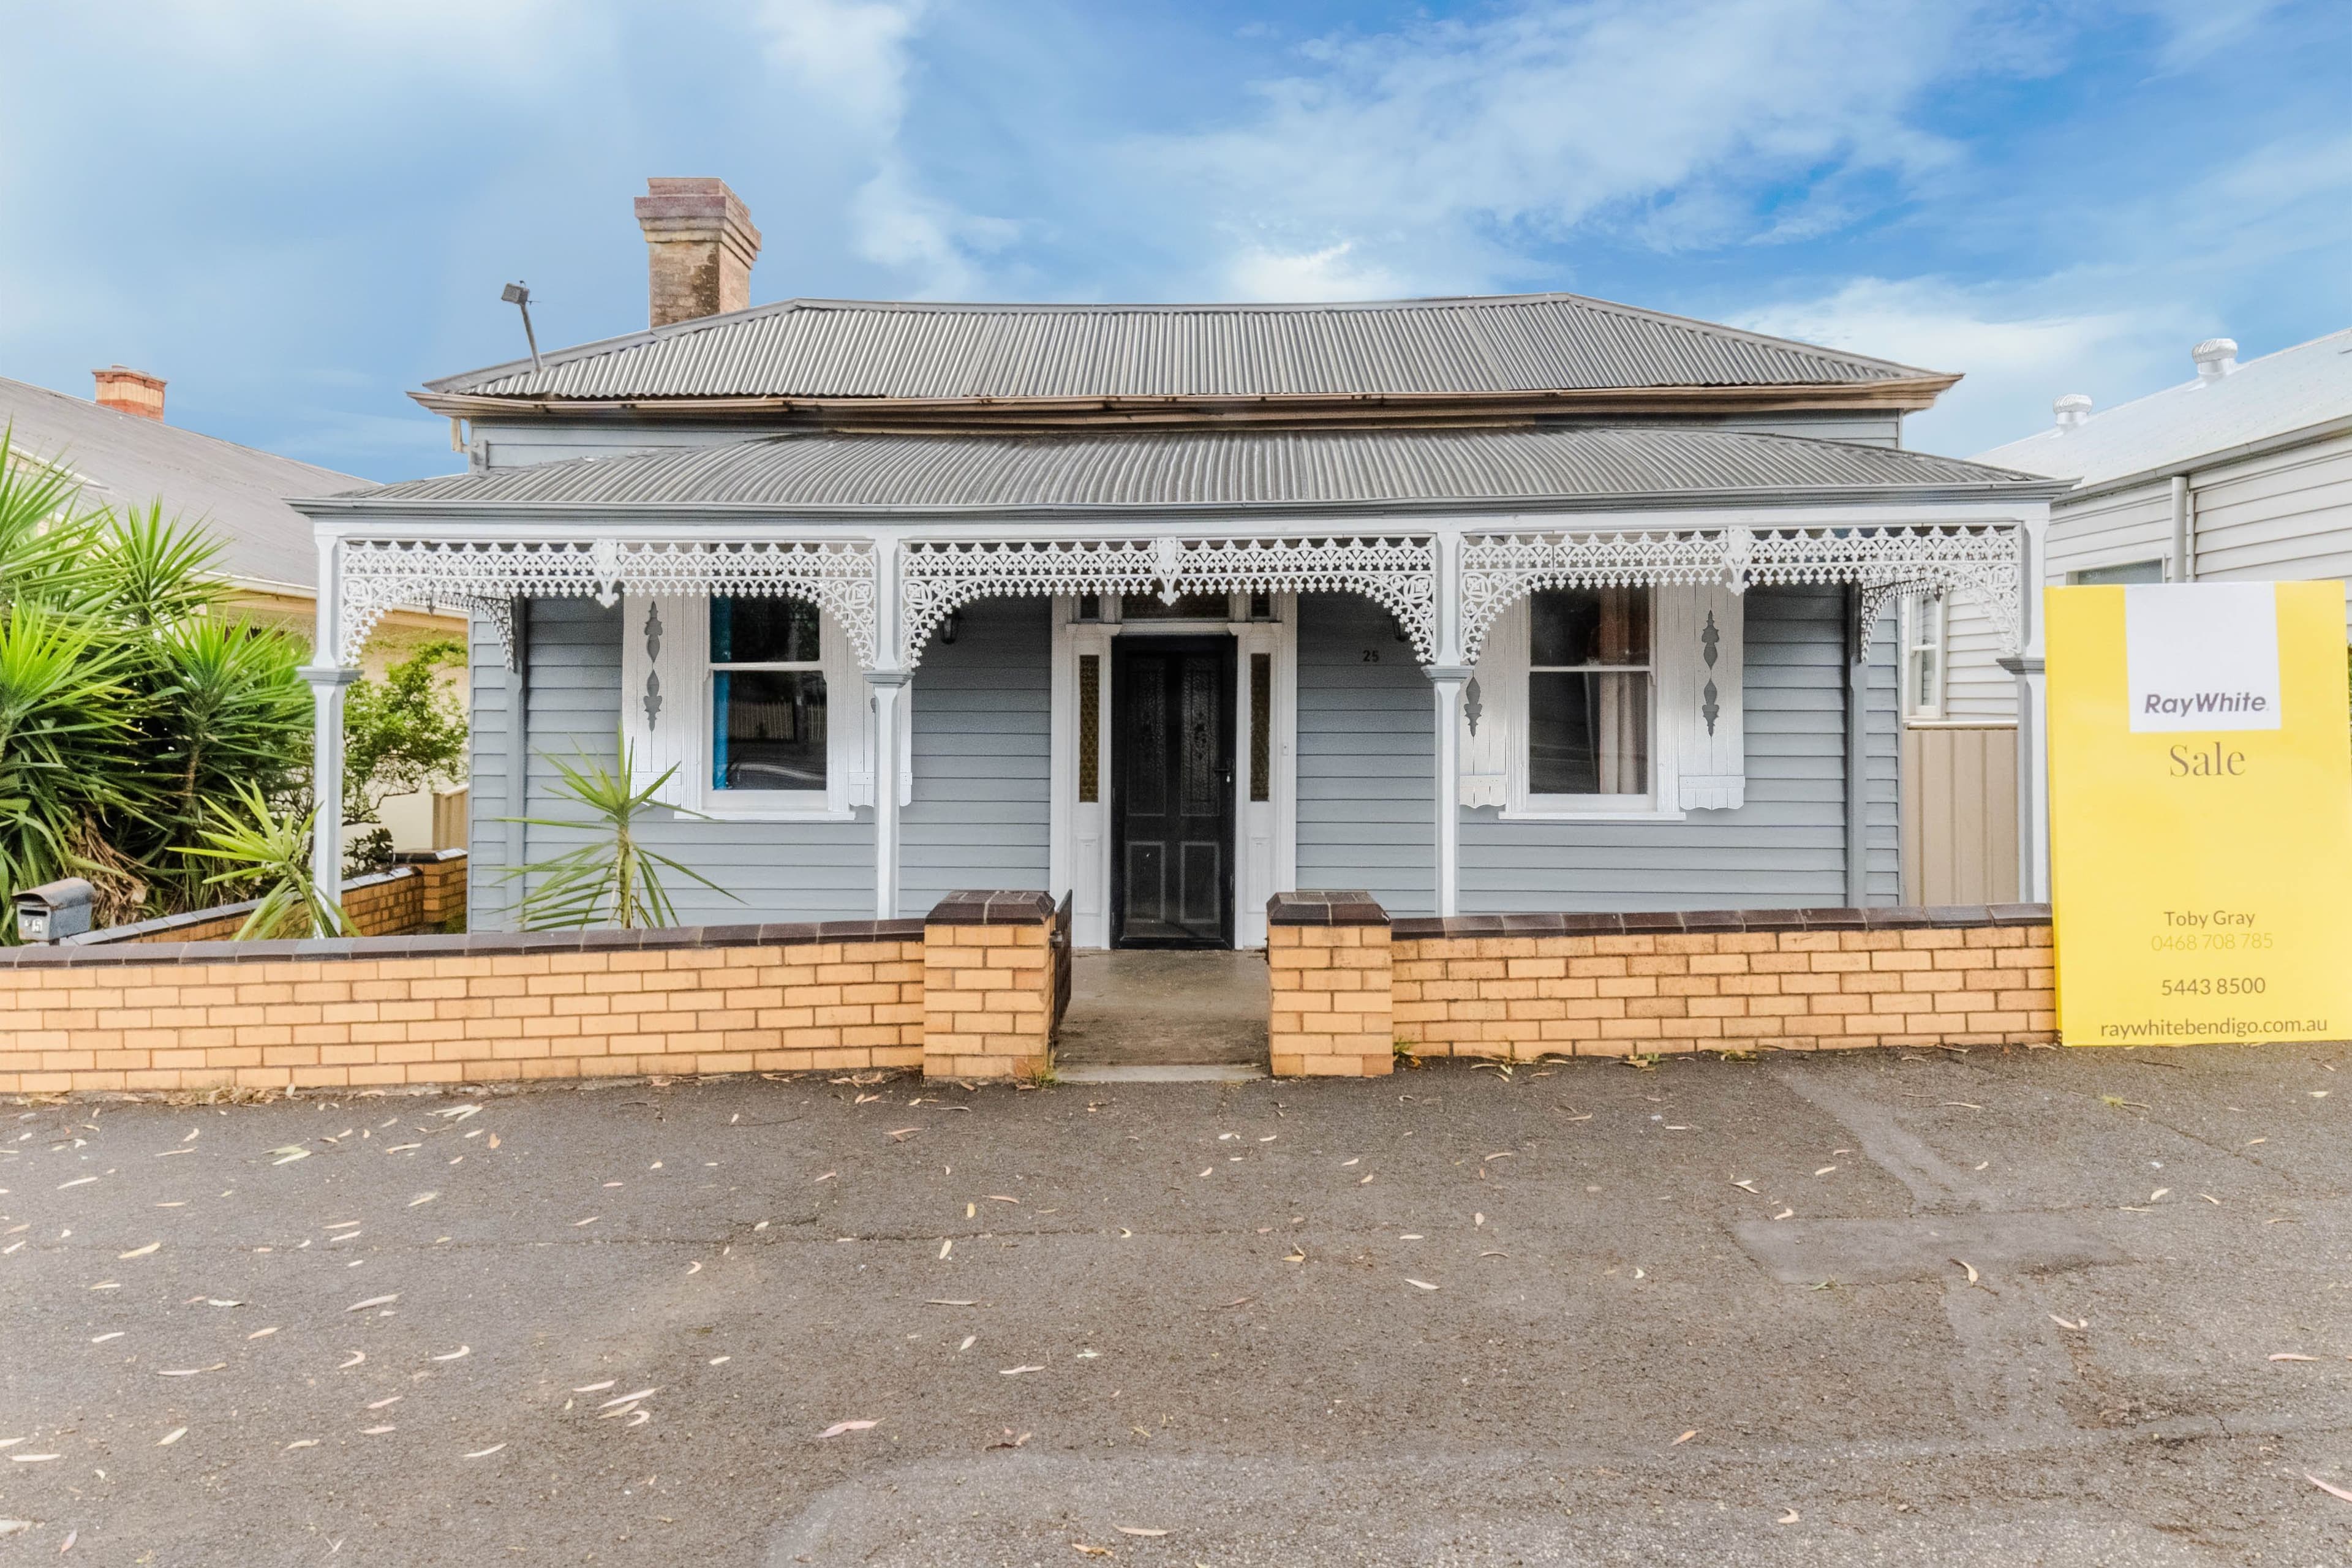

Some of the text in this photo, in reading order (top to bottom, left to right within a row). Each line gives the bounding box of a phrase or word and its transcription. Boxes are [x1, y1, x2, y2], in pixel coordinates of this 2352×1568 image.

[1362, 649, 1379, 663] 25
[2169, 741, 2245, 777] Sale
[2164, 910, 2256, 929] Toby Gray
[2151, 932, 2274, 952] 0468 708 785
[2162, 977, 2266, 996] 5443 8500
[2101, 1017, 2328, 1040] raywhitebendigo.com.au
